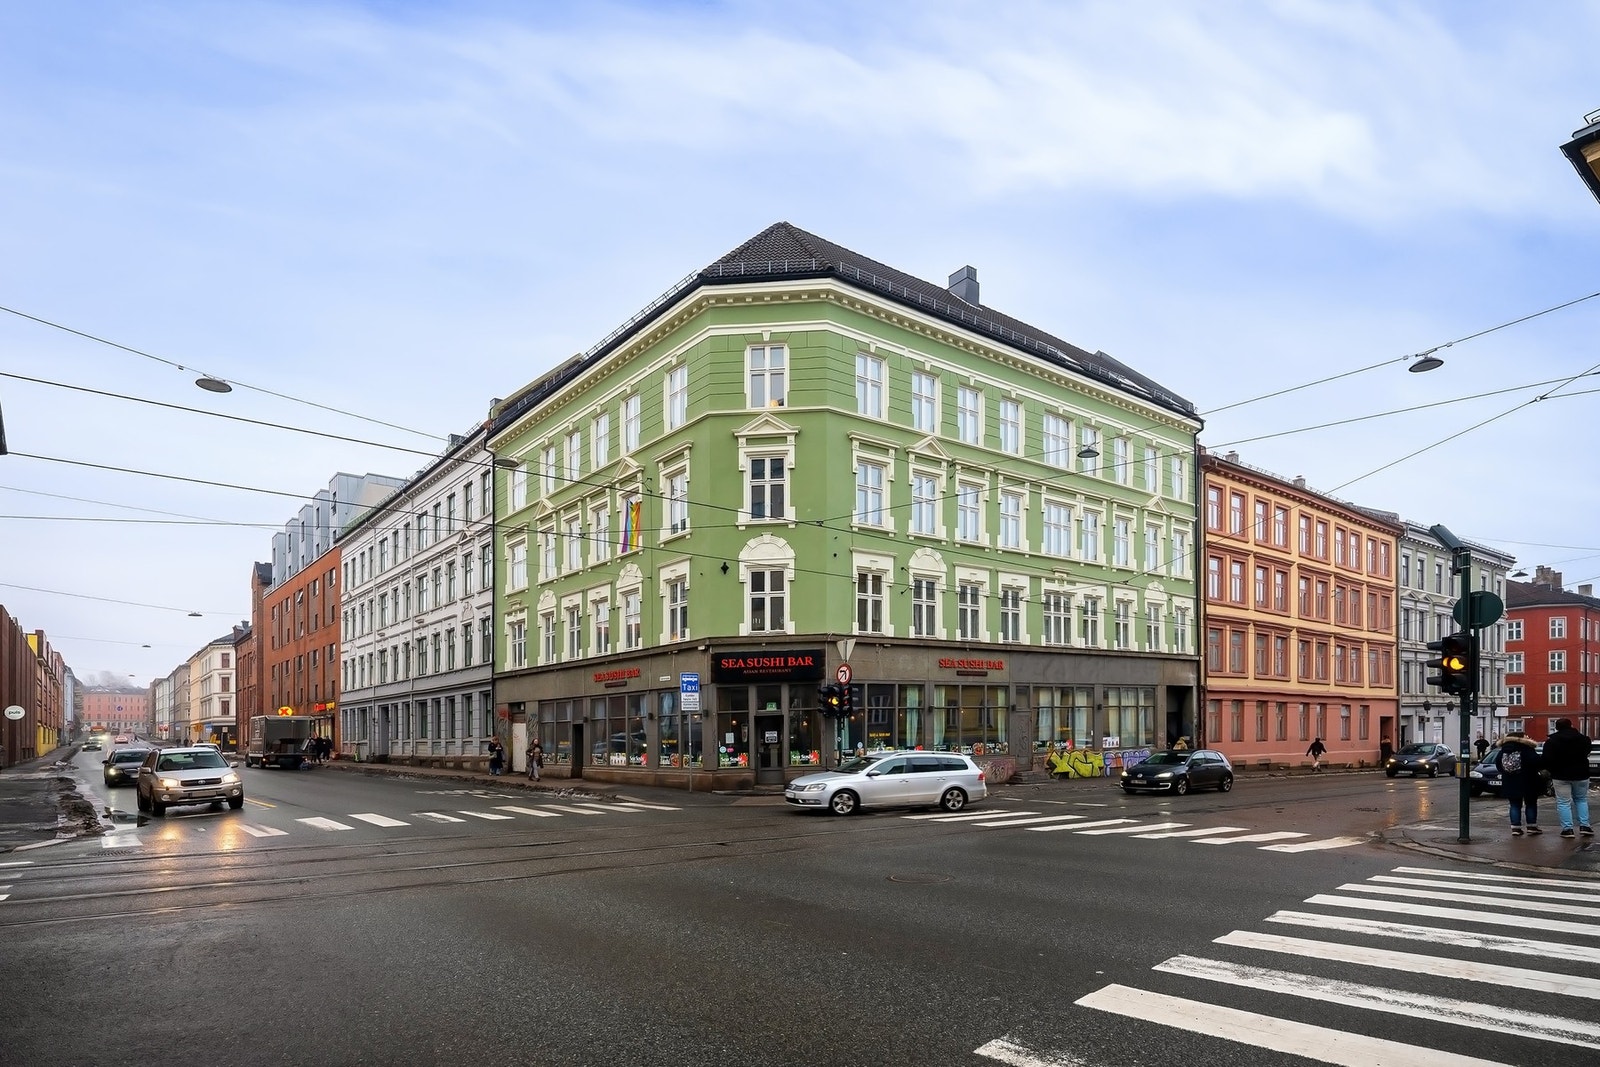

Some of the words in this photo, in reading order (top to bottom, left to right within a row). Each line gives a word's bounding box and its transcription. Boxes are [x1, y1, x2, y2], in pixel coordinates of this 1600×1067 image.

[721, 659, 746, 668] SEA
[747, 657, 785, 668] SUSHI
[788, 656, 814, 666] BAR
[939, 658, 957, 668] SEA
[987, 660, 1004, 670] BAR
[625, 667, 640, 678] BAR
[682, 683, 698, 691] Taxi
